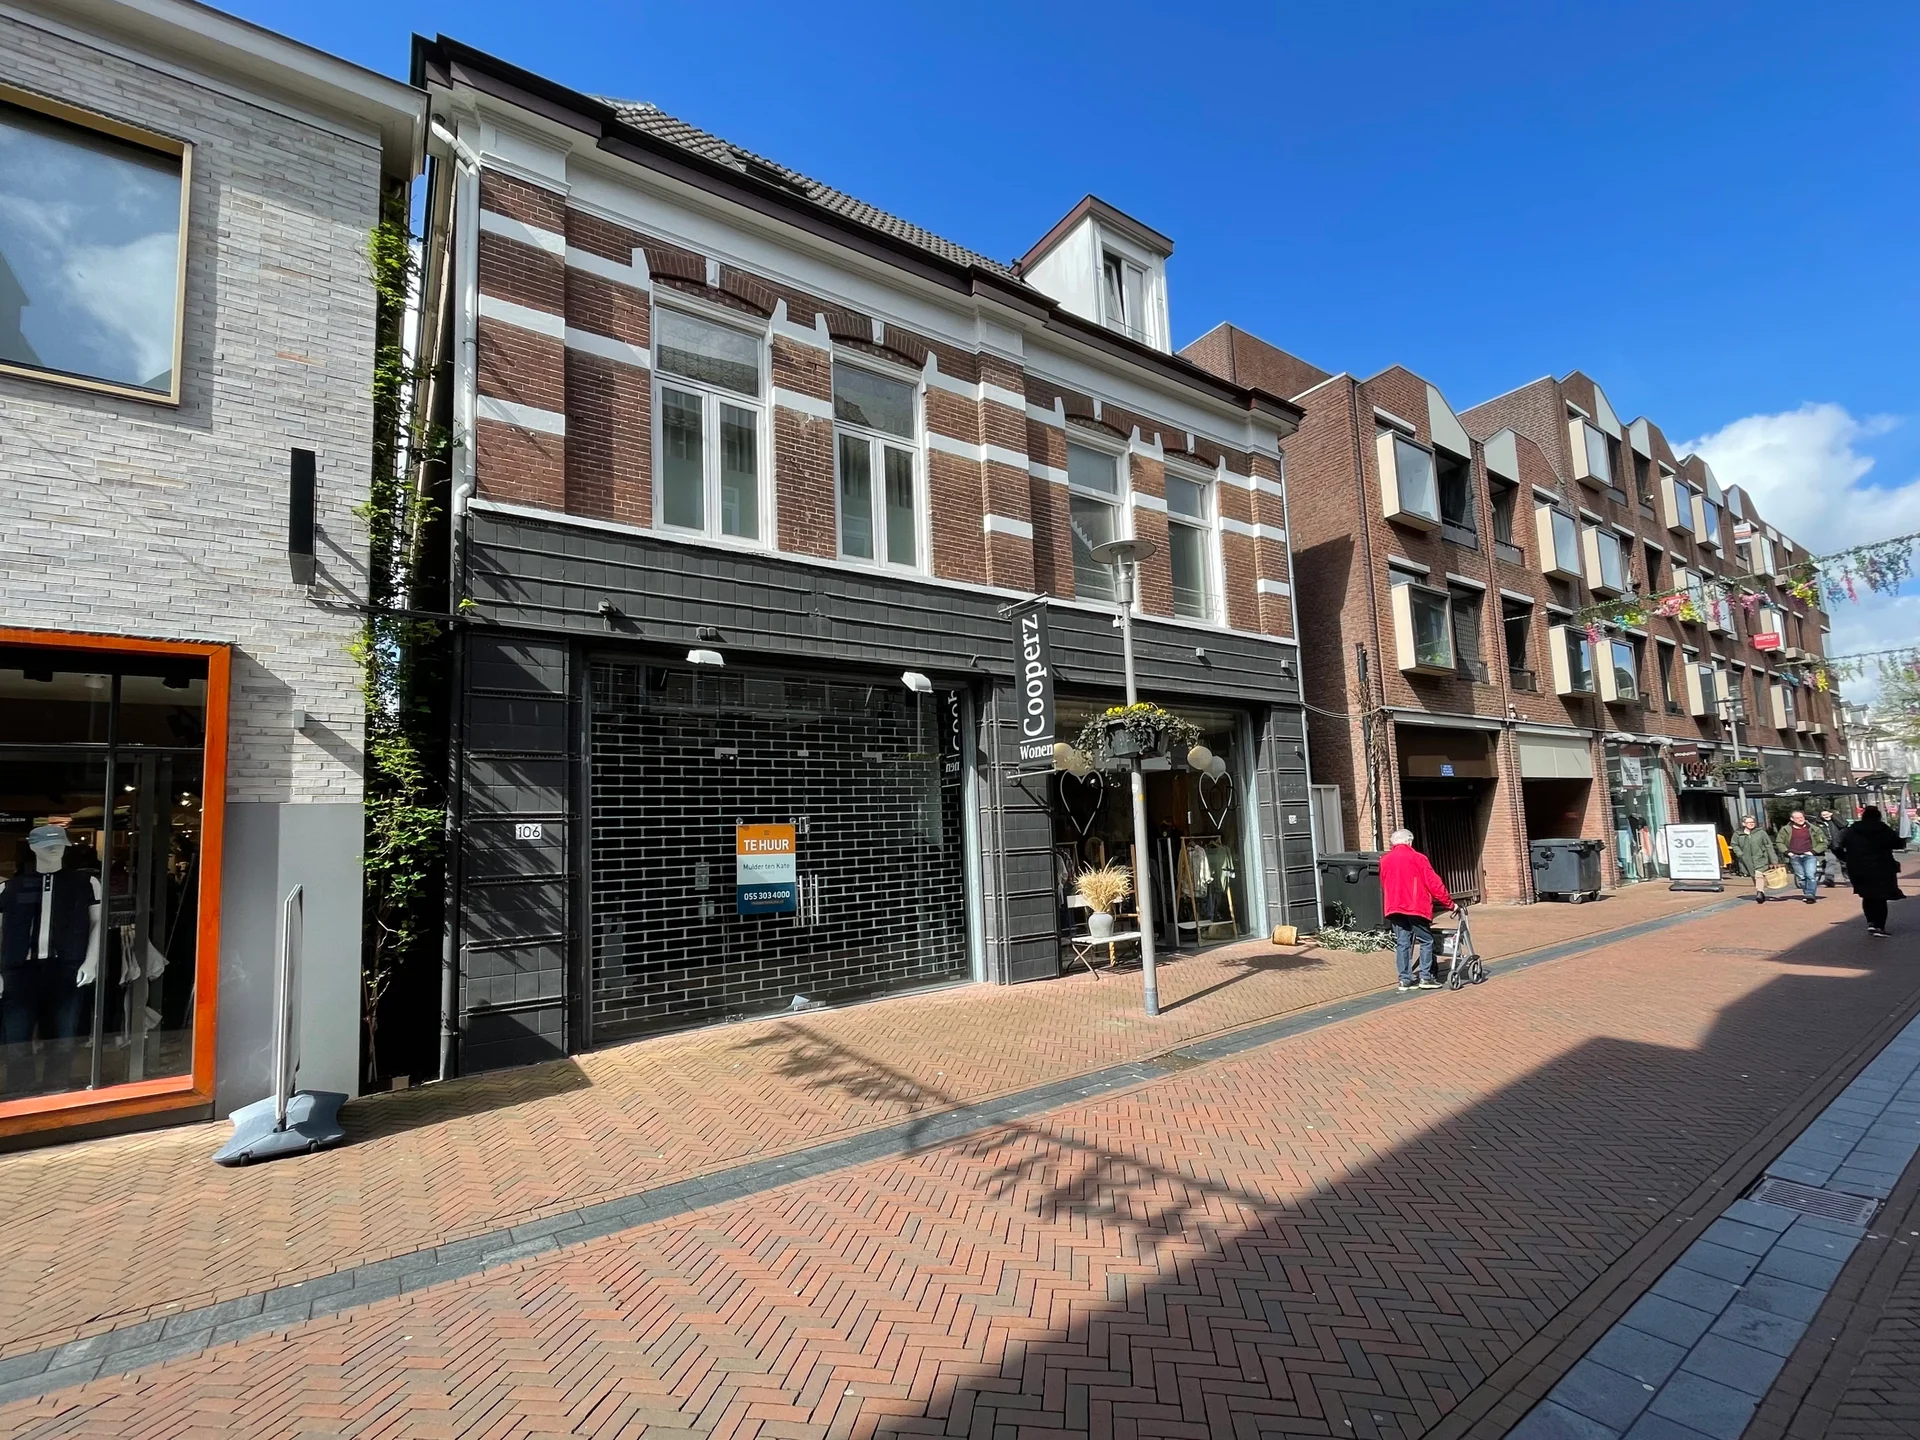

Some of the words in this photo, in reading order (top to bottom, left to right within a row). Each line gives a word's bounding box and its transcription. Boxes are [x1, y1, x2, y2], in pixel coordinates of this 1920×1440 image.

[1021, 613, 1048, 737] Cooperz
[1019, 743, 1054, 760] Wonen
[518, 825, 541, 838] 106
[744, 840, 757, 851] TE
[759, 839, 789, 850] HUUR
[1674, 838, 1695, 849] 30
